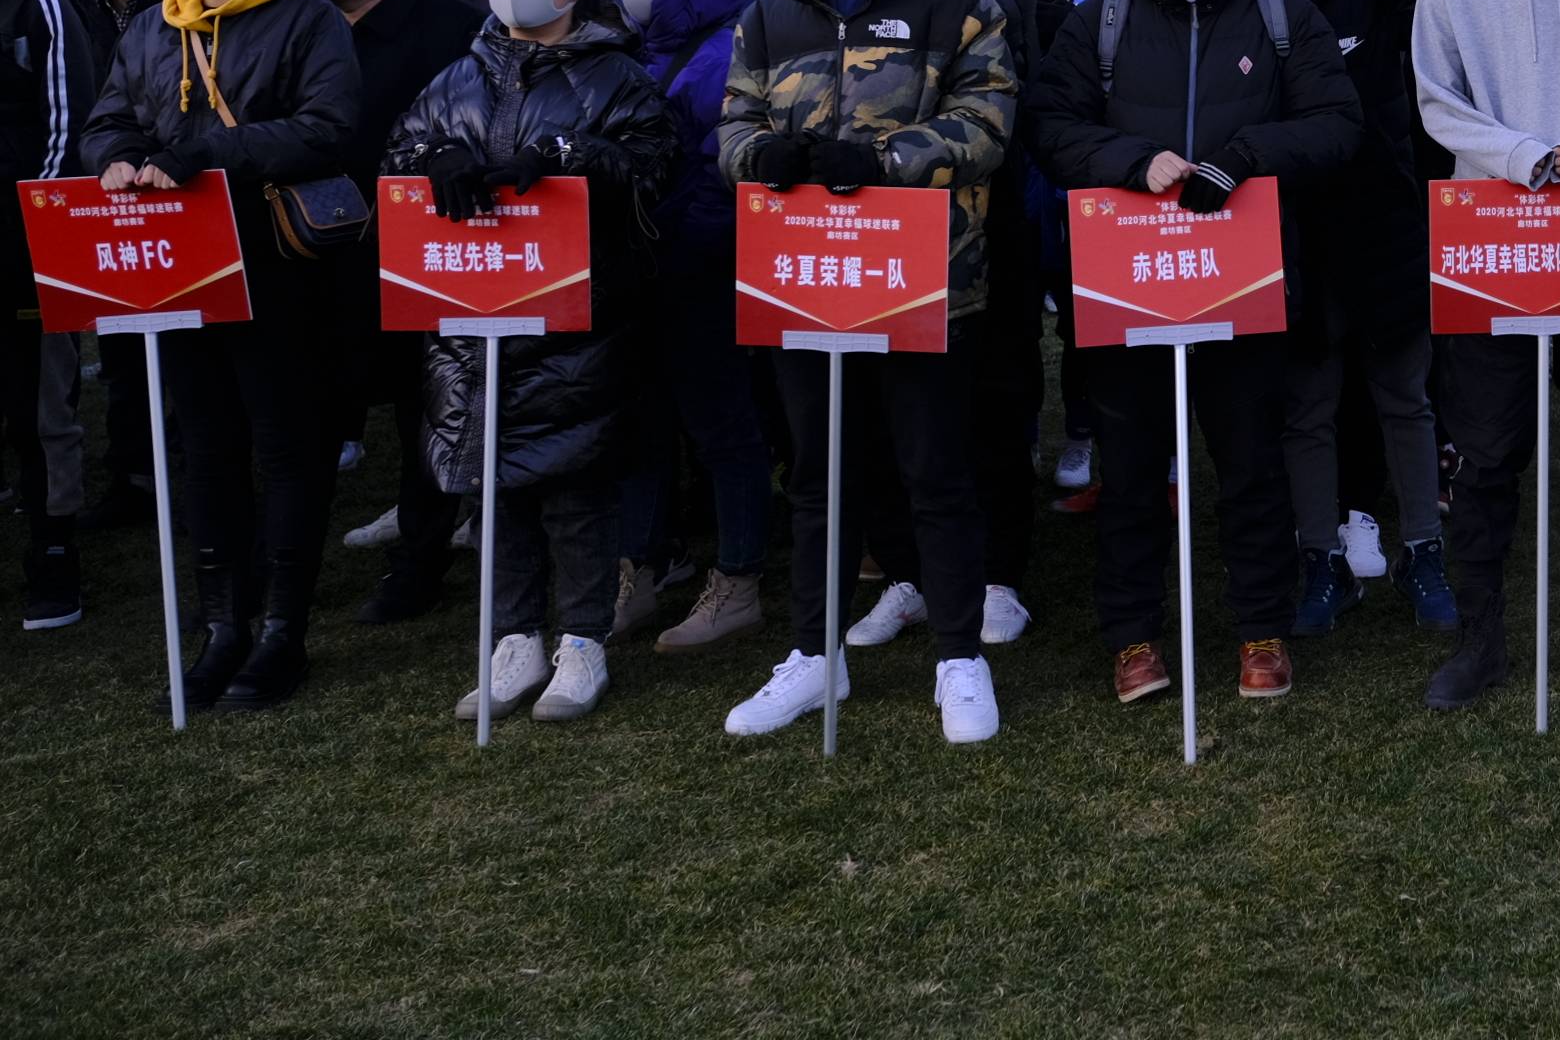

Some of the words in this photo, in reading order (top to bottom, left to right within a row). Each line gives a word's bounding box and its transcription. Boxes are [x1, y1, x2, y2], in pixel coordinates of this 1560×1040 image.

[70, 202, 184, 217] 2020河北华夏幸福球迷联赛
[1156, 201, 1185, 212] “体彩
[785, 216, 900, 231] 2020河北华夏幸福球迷联赛
[96, 239, 174, 272] 风神FC
[424, 242, 544, 272] 燕赵先锋一队
[1132, 248, 1220, 283] 赤焰联队
[774, 254, 906, 289] 华夏荣耀一队
